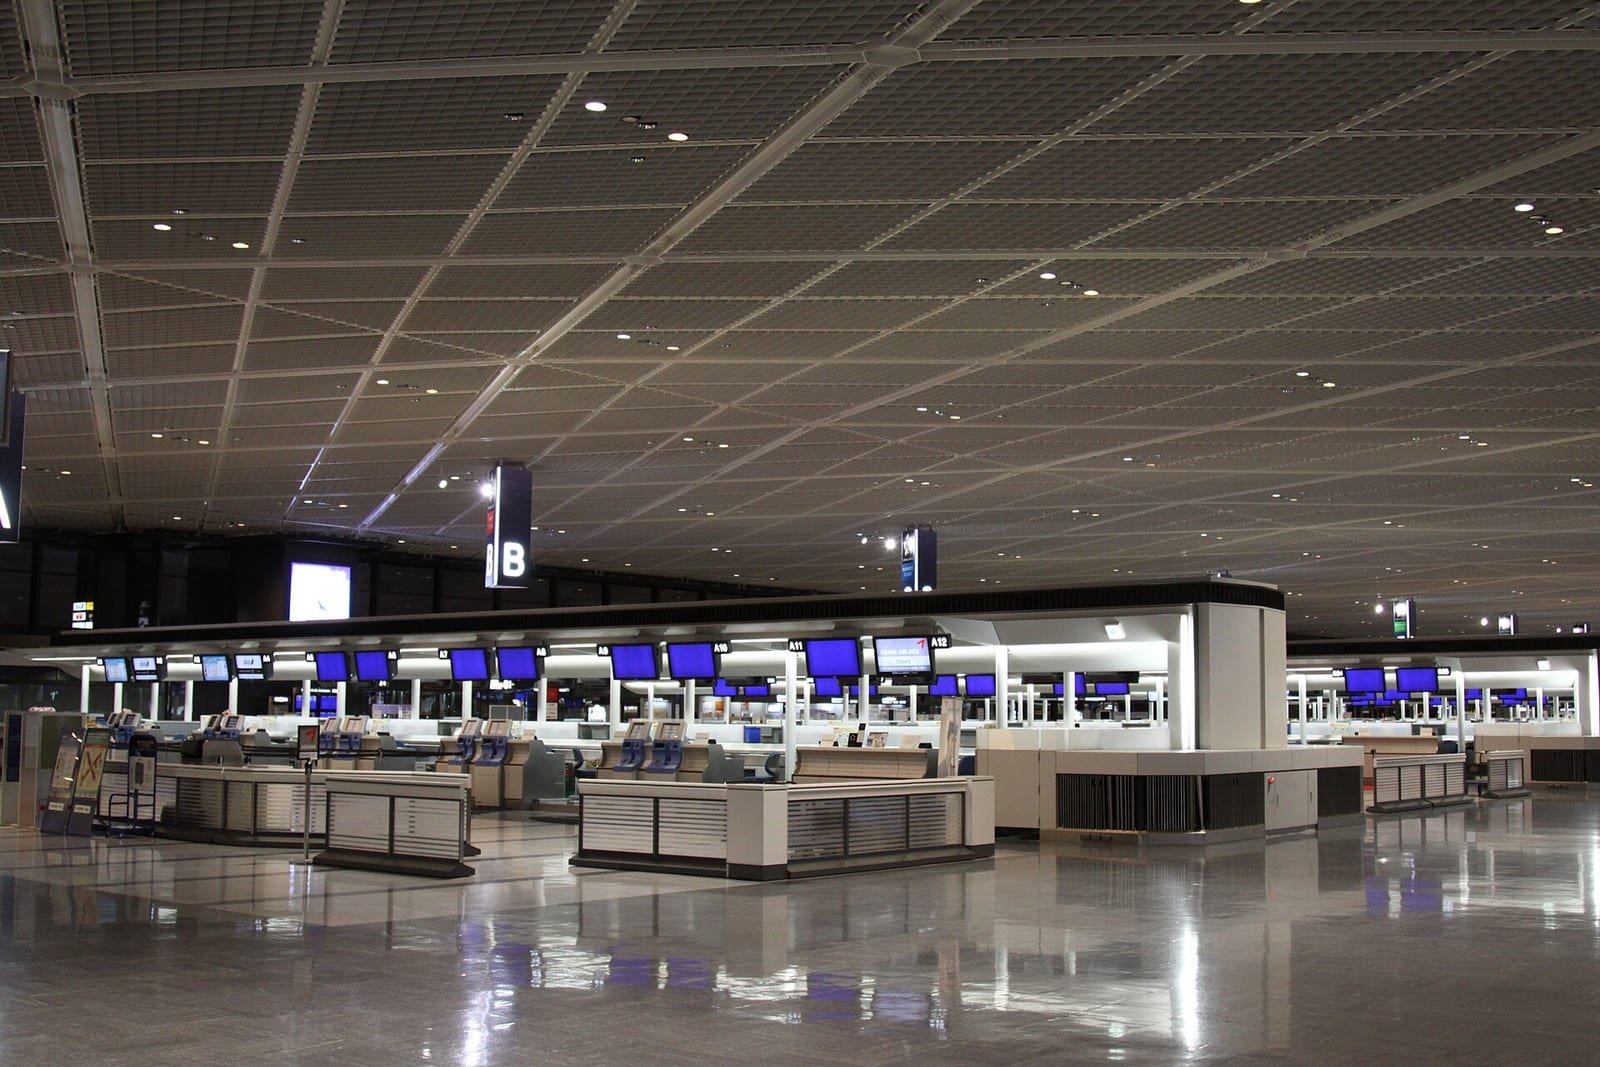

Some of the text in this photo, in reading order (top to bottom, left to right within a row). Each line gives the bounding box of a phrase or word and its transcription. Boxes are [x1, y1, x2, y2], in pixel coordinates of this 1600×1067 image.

[503, 542, 525, 577] B
[789, 641, 803, 651] A11
[931, 637, 948, 647] A12
[714, 643, 728, 653] A10
